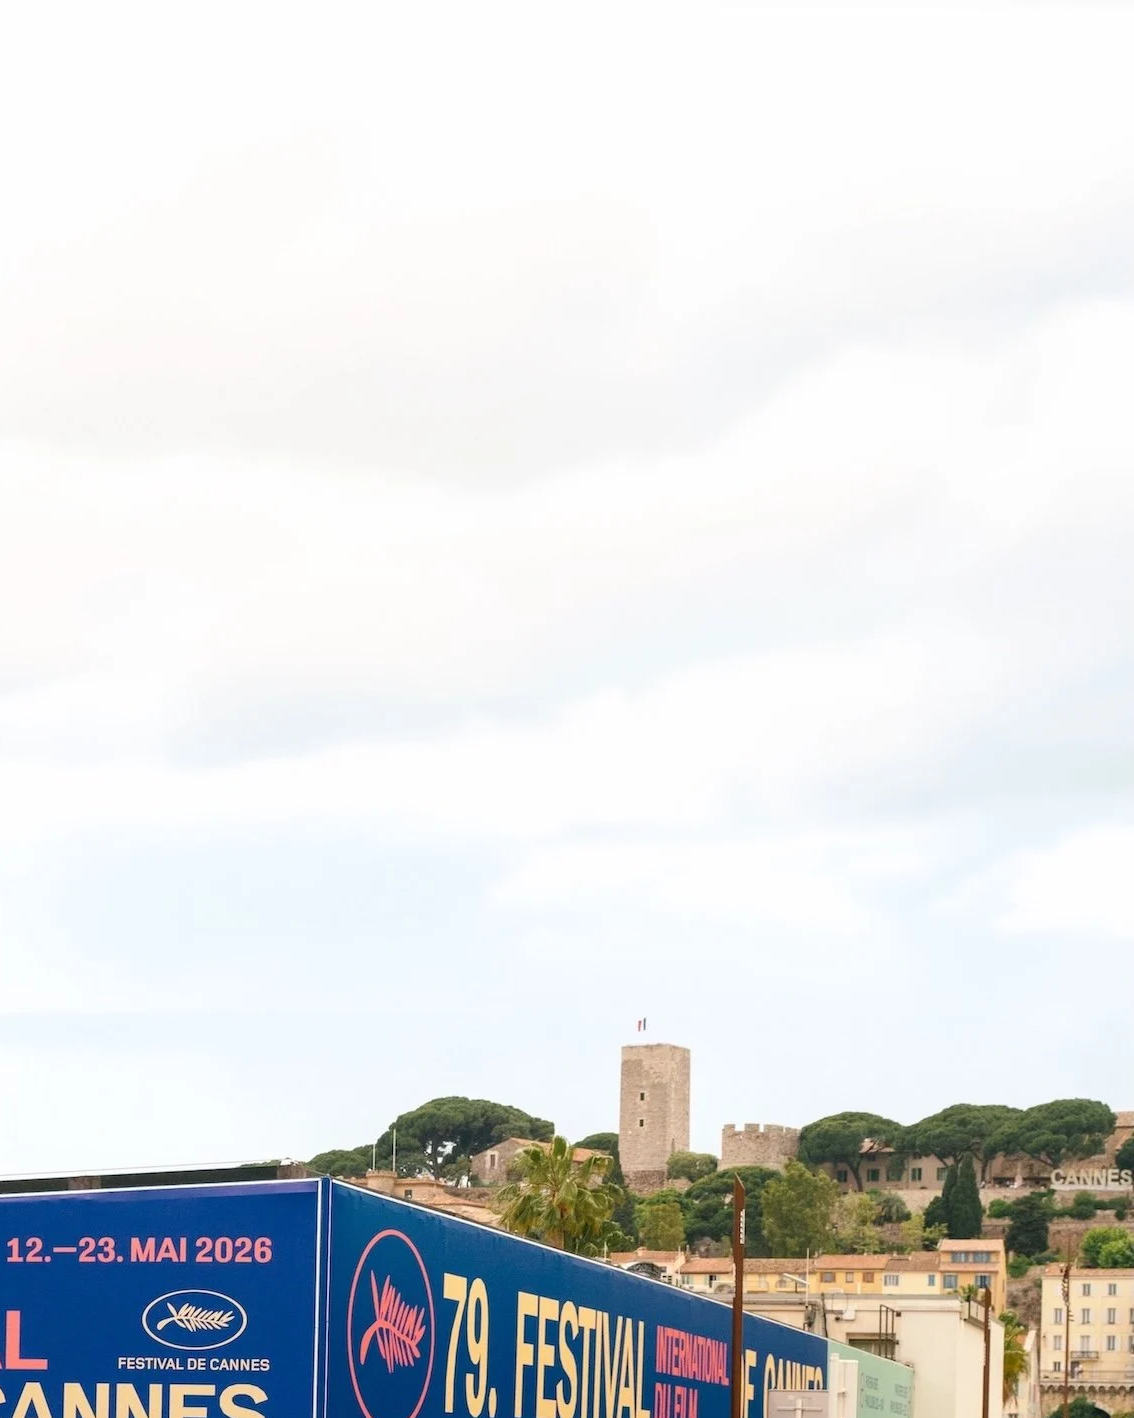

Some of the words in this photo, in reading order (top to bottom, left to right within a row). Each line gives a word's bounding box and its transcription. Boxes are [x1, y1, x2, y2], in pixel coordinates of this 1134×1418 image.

[1050, 1168, 1133, 1186] CANNES
[130, 1237, 187, 1263] MAI
[195, 1236, 272, 1263] 2026
[443, 1272, 497, 1418] 79.
[655, 1325, 730, 1386] INTERNATIONAL
[118, 1357, 185, 1370] FESTIVAL
[187, 1357, 206, 1371] DE
[209, 1358, 270, 1372] CANNES
